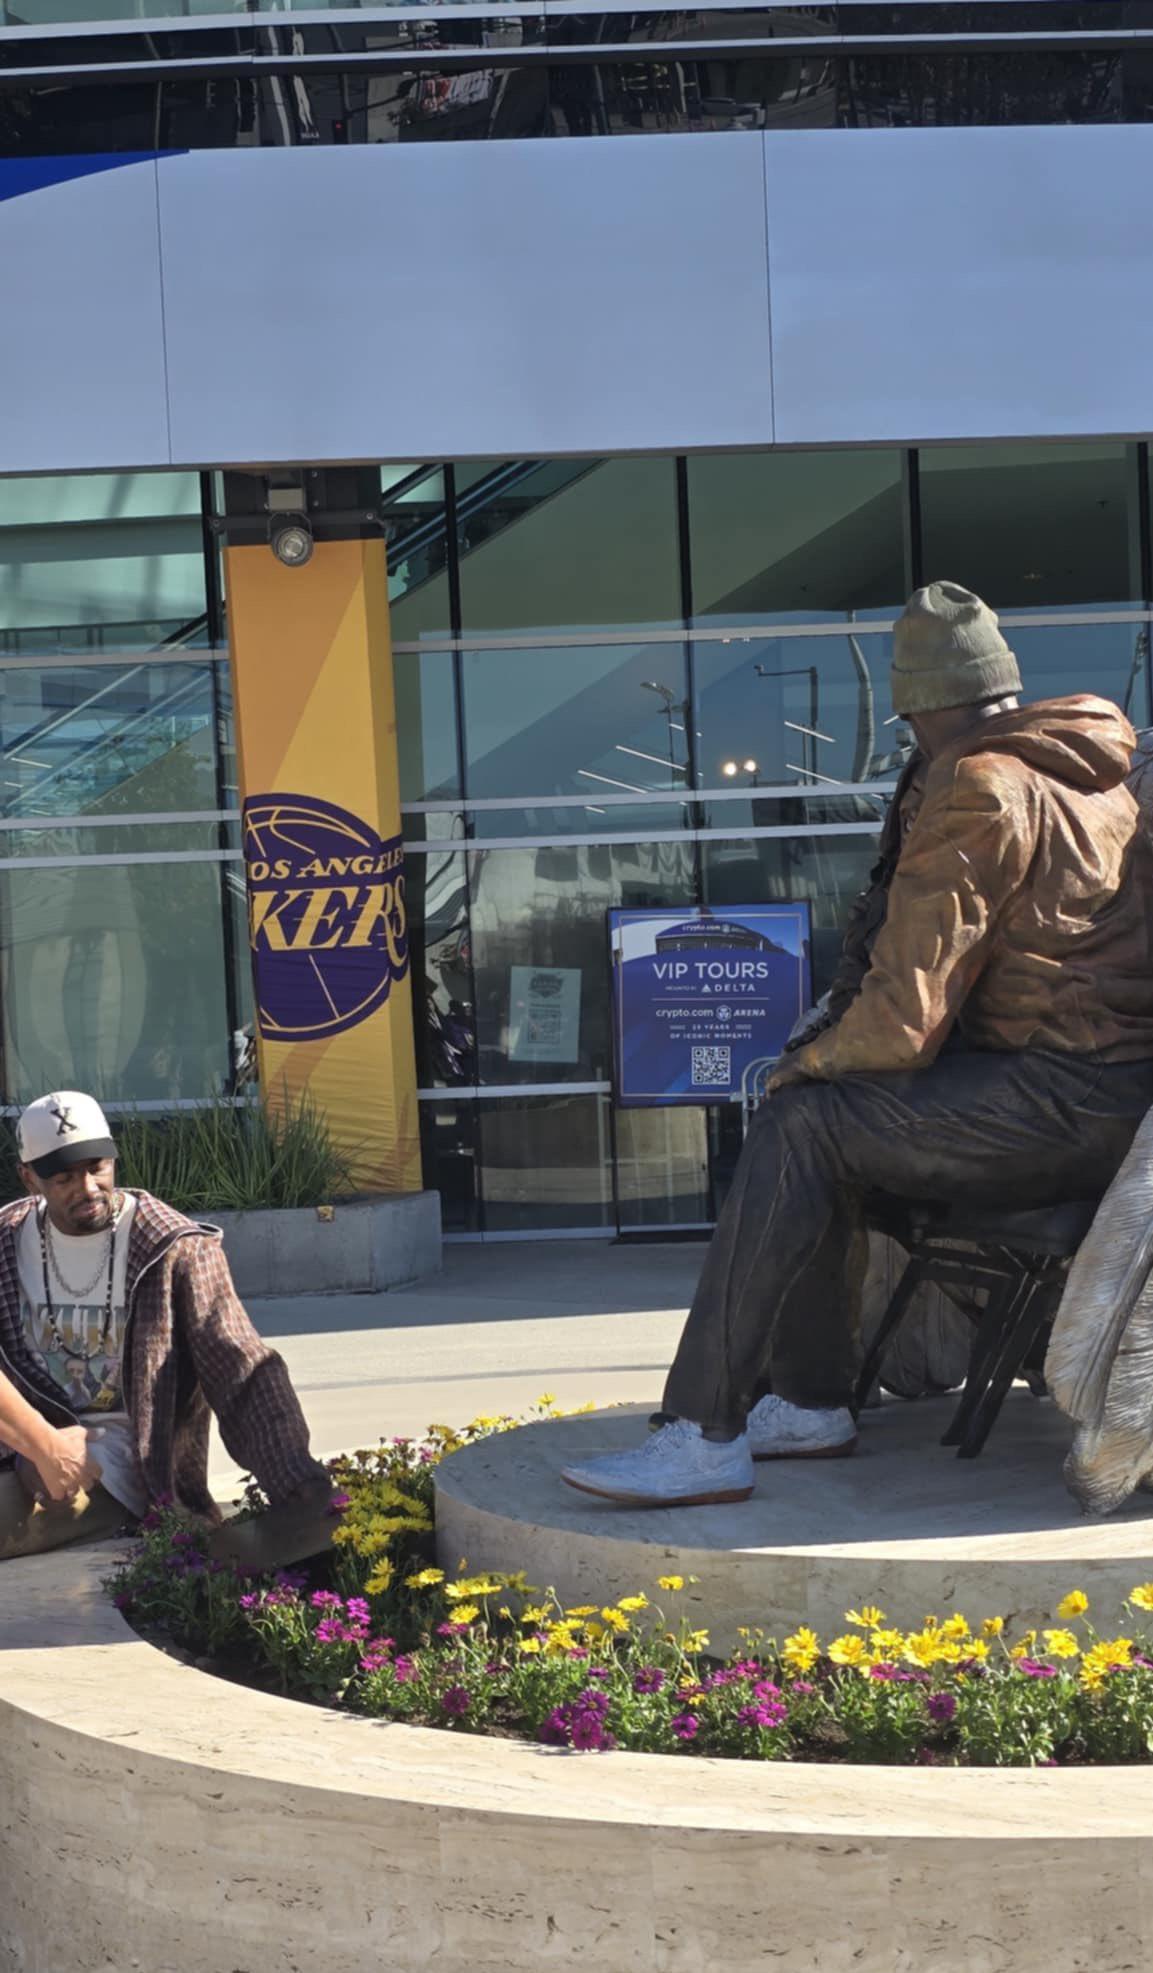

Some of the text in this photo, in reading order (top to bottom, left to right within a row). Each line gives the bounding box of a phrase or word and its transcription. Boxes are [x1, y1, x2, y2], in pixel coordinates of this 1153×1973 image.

[248, 847, 404, 881] OS ANGELE
[249, 875, 407, 968] KERS
[652, 962, 769, 979] VIP TOURS
[714, 984, 756, 992] DELTA
[655, 1008, 766, 1018] crypto.com ARENA
[50, 1107, 78, 1136] X
